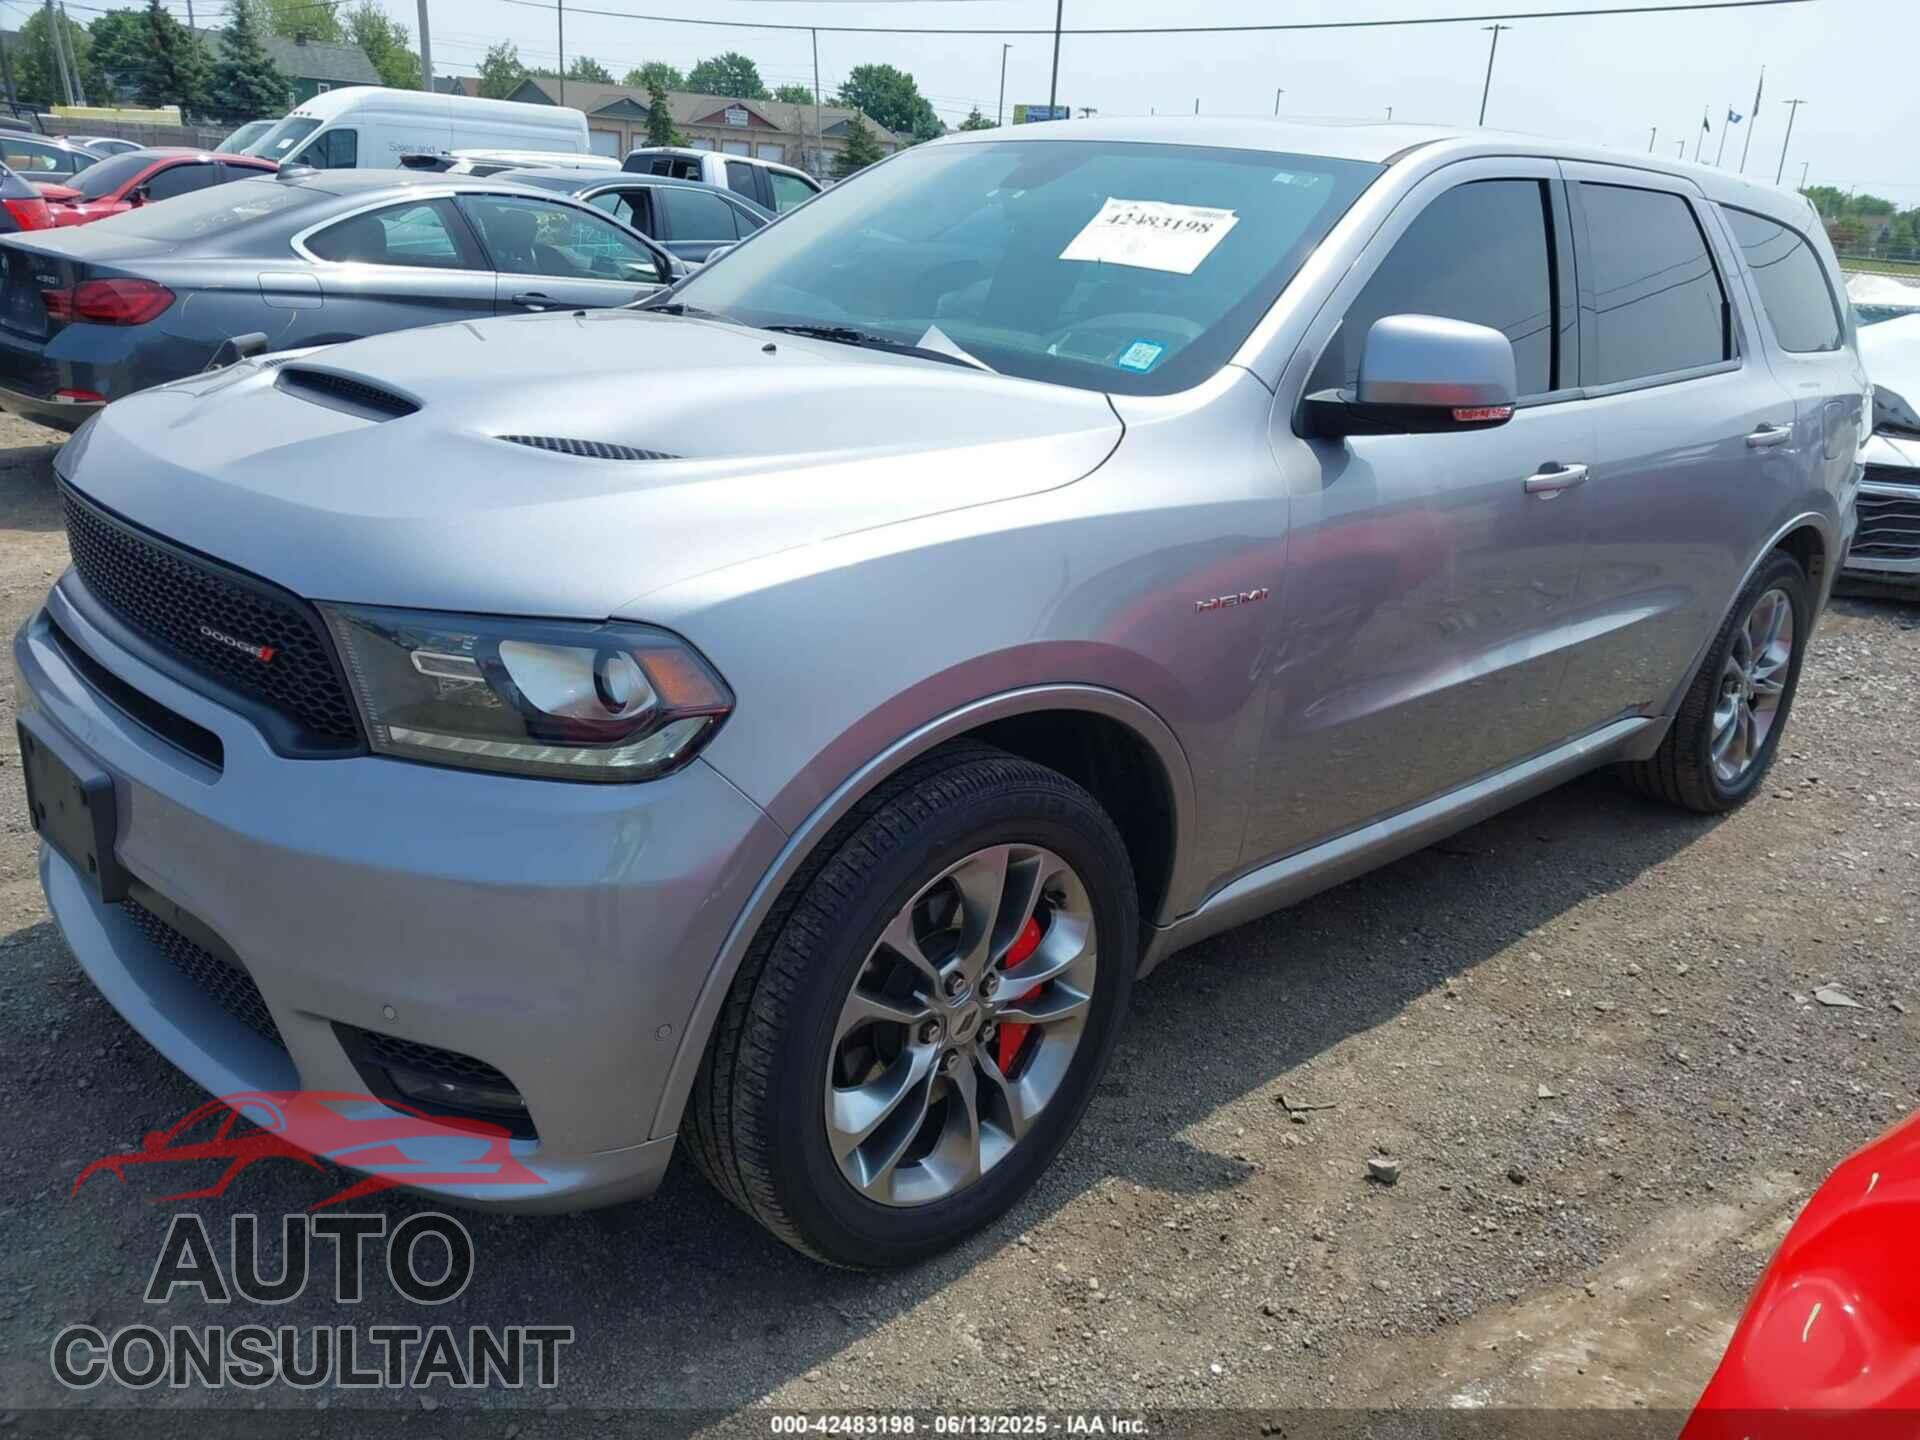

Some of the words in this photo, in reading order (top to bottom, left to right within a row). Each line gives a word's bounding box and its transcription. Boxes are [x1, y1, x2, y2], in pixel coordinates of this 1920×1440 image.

[1106, 212, 1214, 233] 42483198
[1193, 587, 1269, 614] HEMI
[200, 625, 262, 657] DODGE
